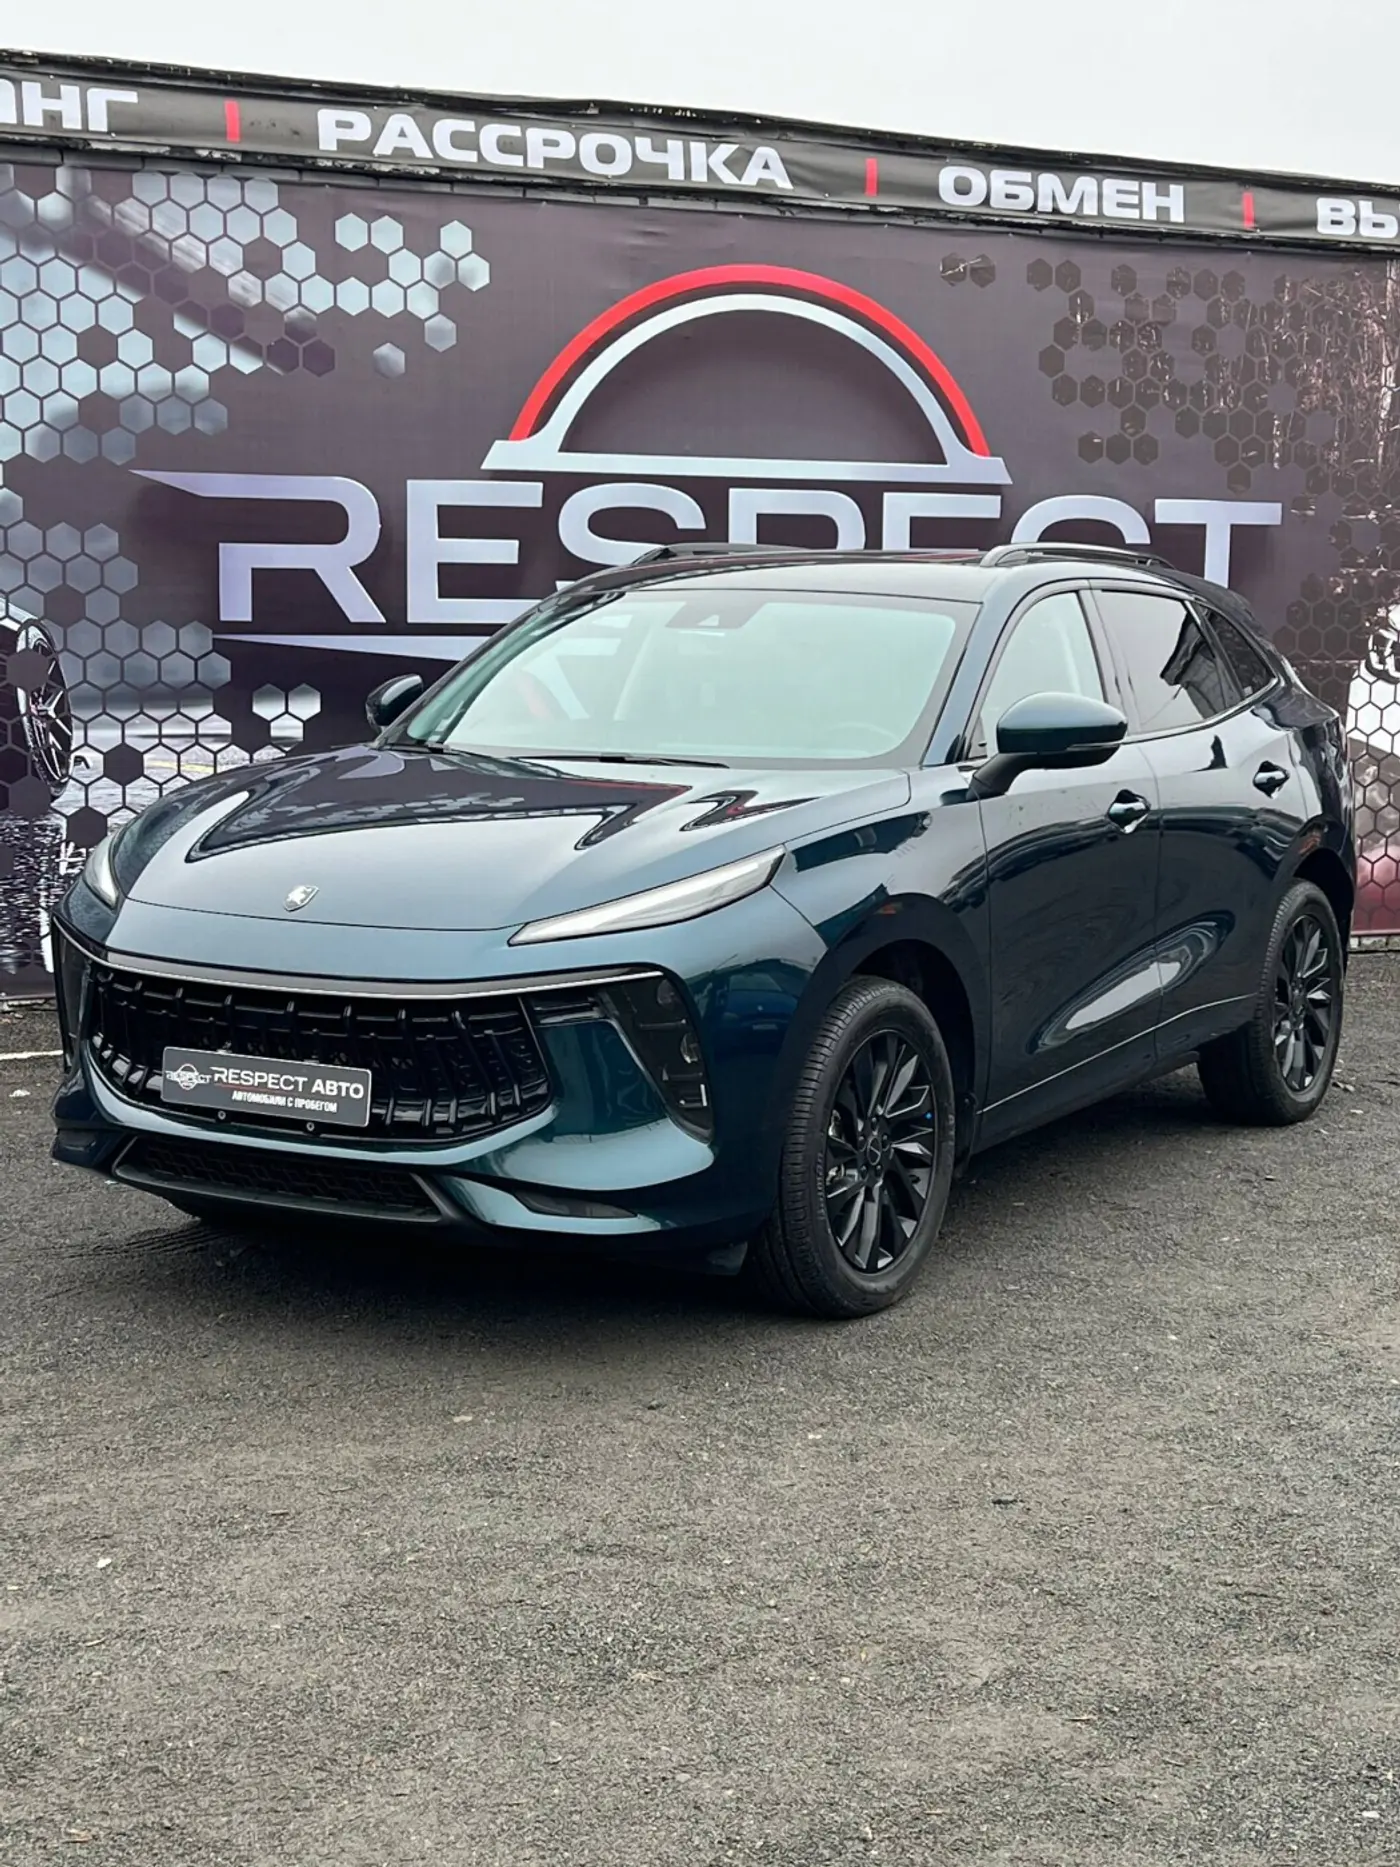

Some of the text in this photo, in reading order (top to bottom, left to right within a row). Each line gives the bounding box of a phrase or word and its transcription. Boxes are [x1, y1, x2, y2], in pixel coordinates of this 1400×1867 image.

[317, 108, 794, 190] РАССРОЧКА
[938, 165, 1185, 223] ОБМЕН
[209, 1066, 364, 1099] RESPECT АВТО
[231, 1090, 338, 1113] АВТОМОБИЛИ С ПРОБЕГОМ
